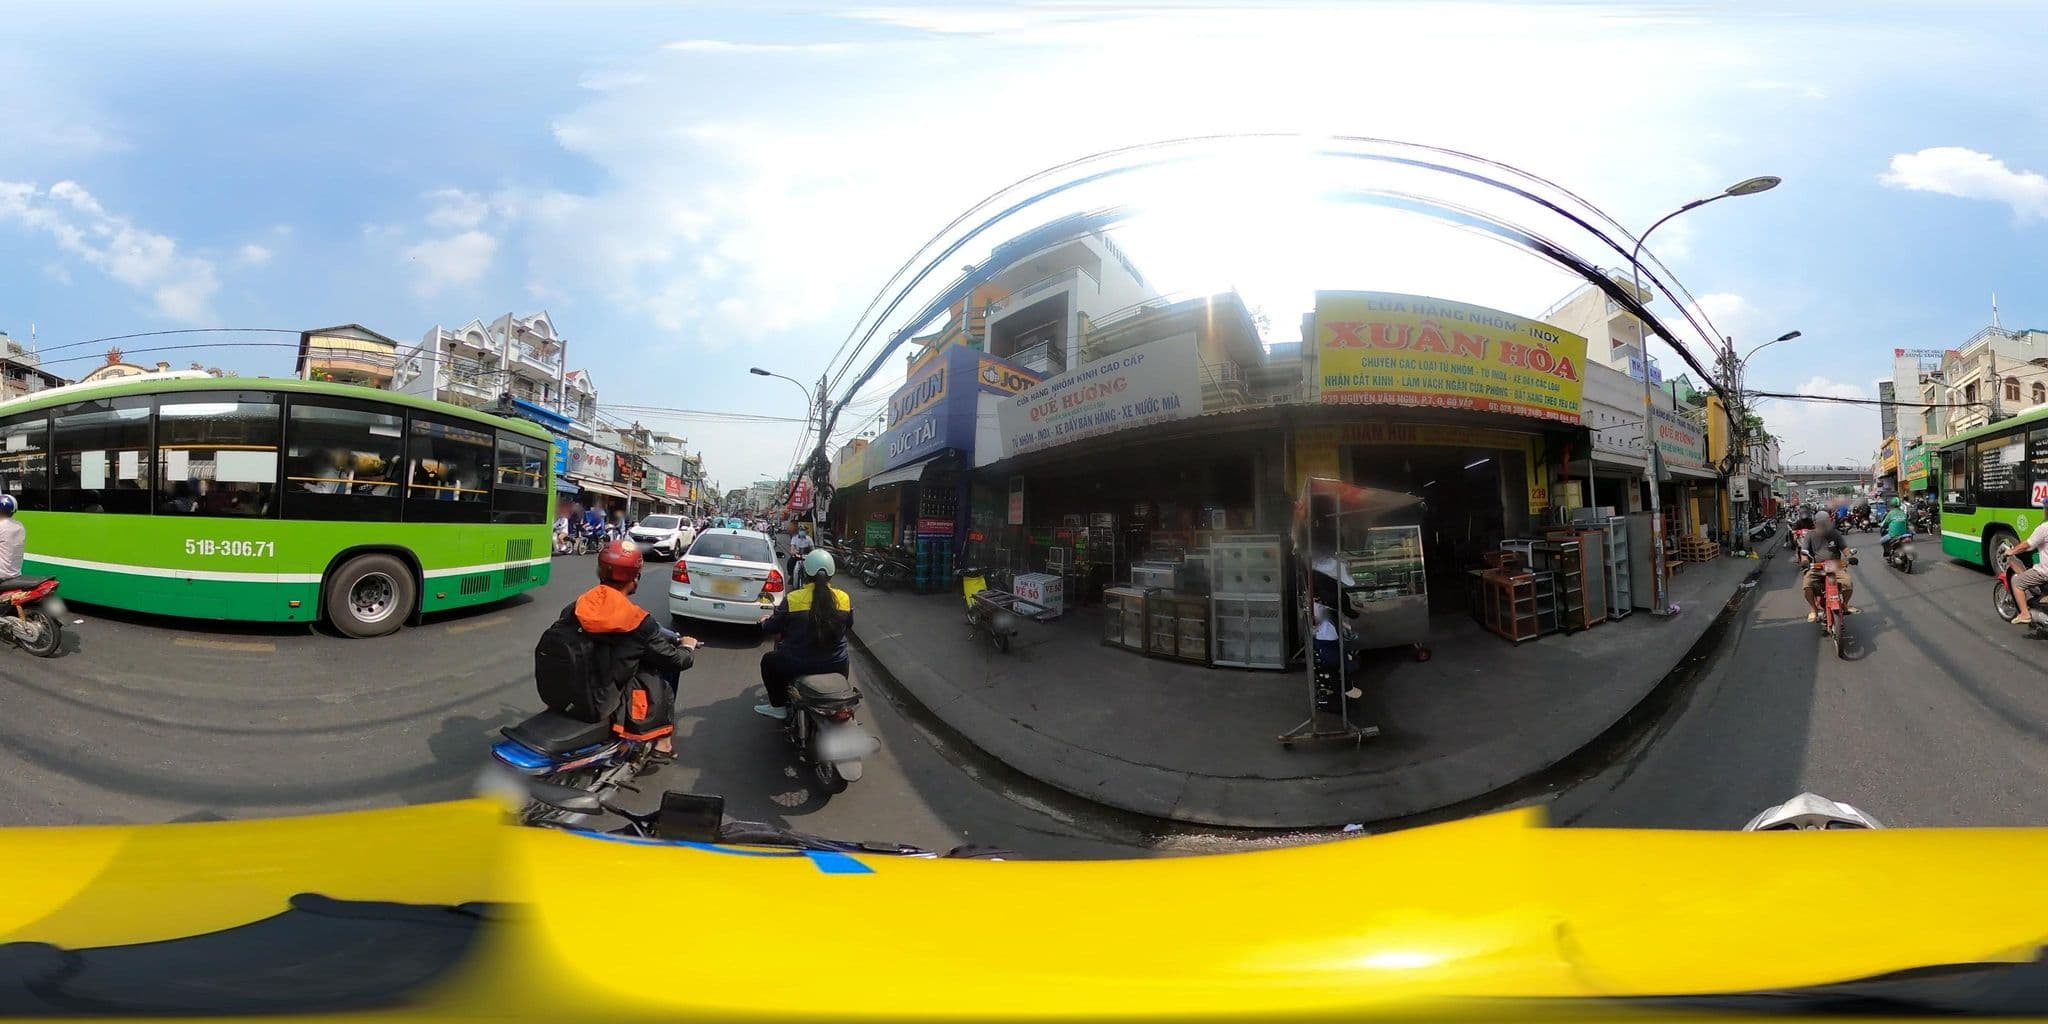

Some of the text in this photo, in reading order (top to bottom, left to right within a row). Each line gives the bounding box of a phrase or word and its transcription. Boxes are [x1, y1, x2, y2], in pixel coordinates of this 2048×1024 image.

[1469, 311, 1518, 332] NHÔM
[1529, 327, 1560, 344] INOX
[1325, 319, 1579, 382] XUÂN HÒA
[898, 367, 944, 421] JOTUN
[1051, 376, 1075, 394] NHÔM
[1100, 361, 1121, 375] CAO
[1029, 393, 1059, 422] QUẾ
[1061, 376, 1127, 409] HƯƠNG
[1121, 404, 1133, 419] XE
[1134, 396, 1160, 416] NƯỚC
[889, 418, 938, 459] ĐỨC TÀI
[185, 538, 275, 557] 51B-306.71
[1015, 585, 1026, 597] VÉ
[1028, 588, 1039, 600] SỐ
